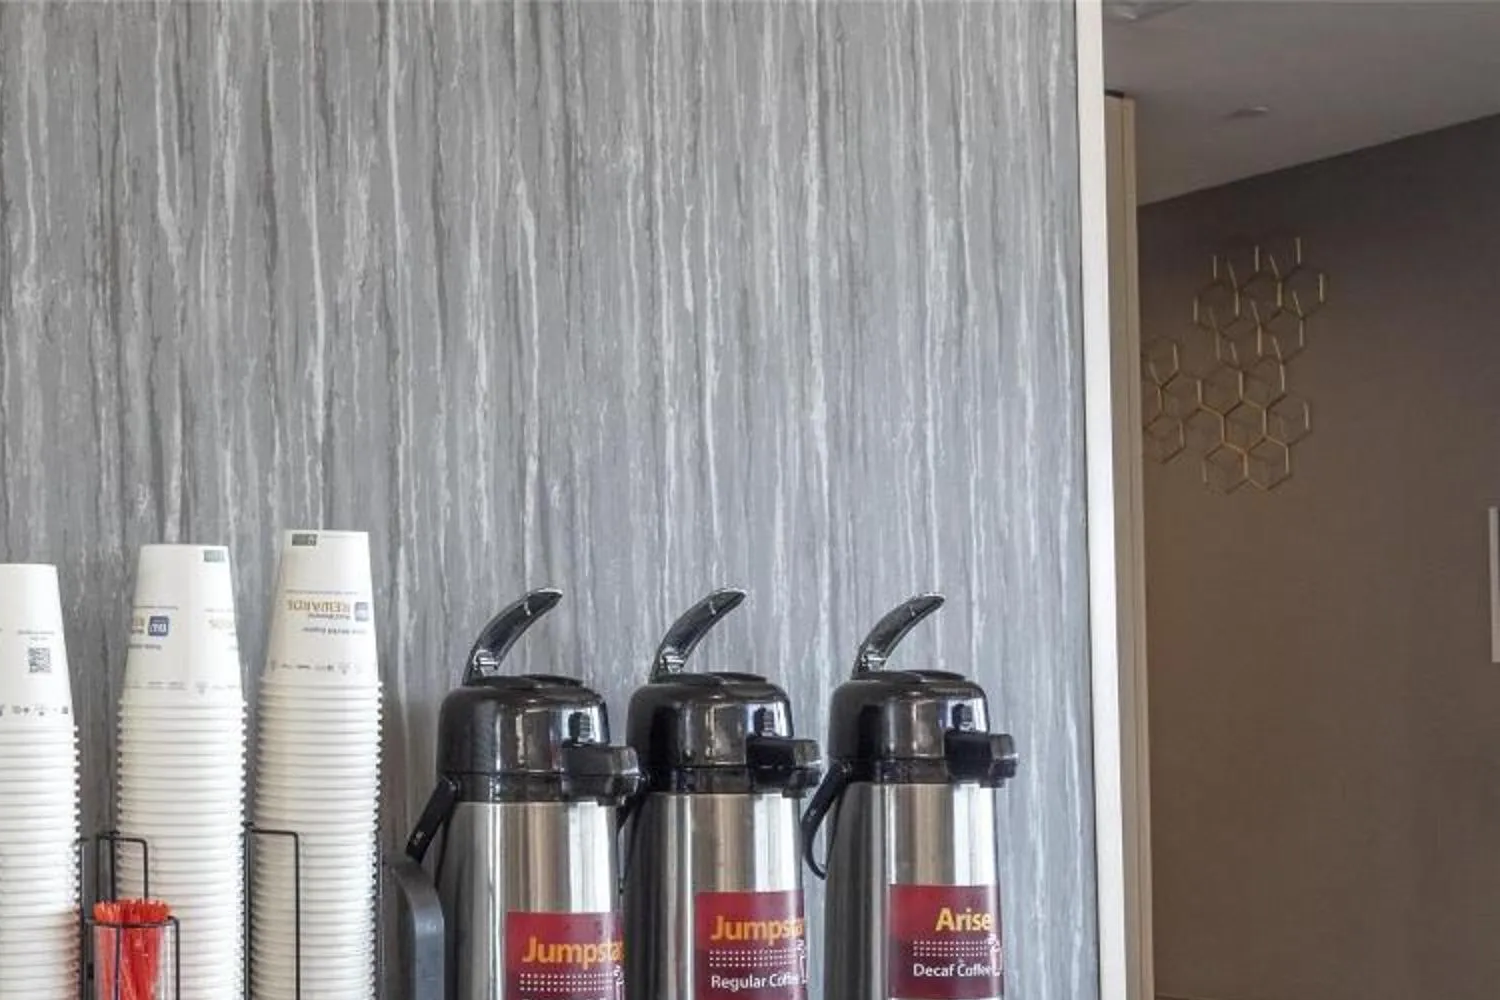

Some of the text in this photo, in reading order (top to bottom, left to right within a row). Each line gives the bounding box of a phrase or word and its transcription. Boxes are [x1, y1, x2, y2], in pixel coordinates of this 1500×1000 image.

[935, 907, 994, 932] Arise
[913, 961, 993, 977] Decaf Coffee
[711, 974, 766, 993] Regular
